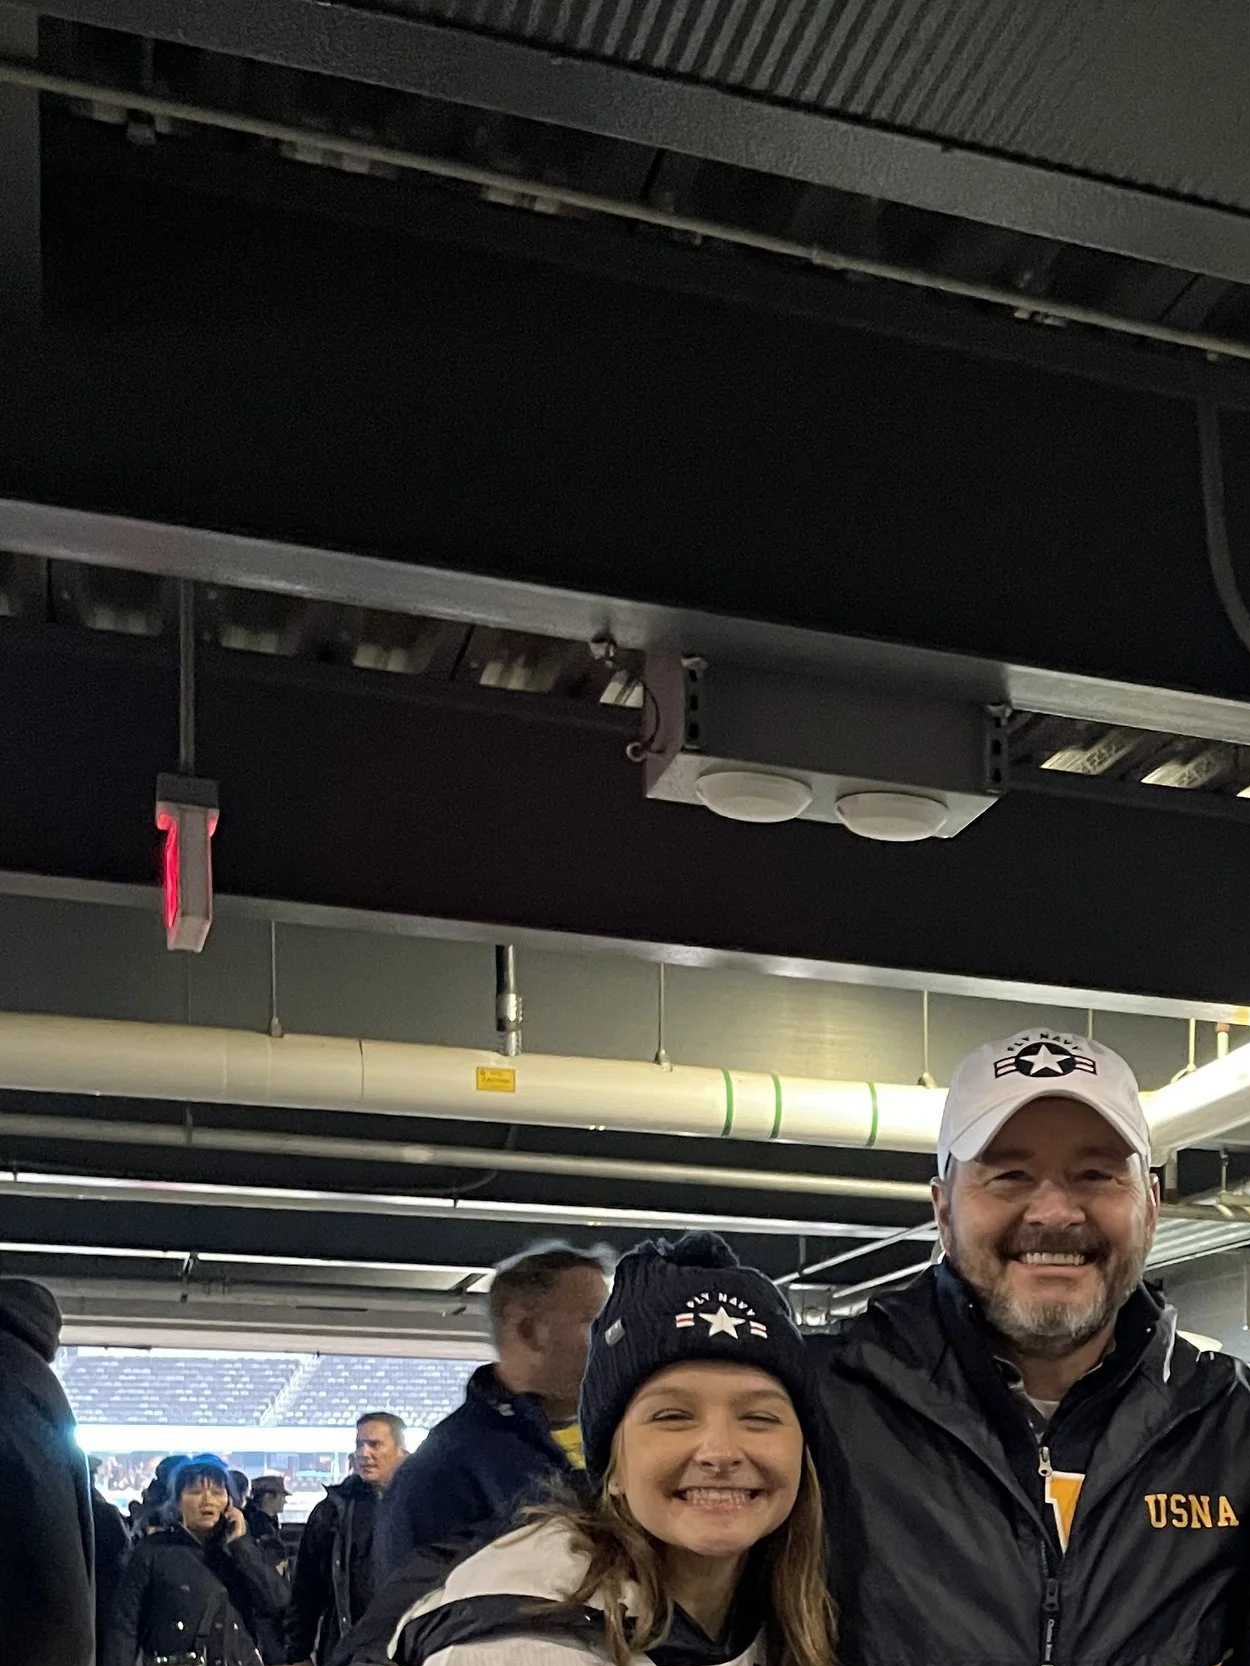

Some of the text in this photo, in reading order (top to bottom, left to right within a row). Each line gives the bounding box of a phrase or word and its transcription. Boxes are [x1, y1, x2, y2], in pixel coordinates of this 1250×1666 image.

[1007, 1033, 1082, 1051] FLY NAVY
[686, 1292, 756, 1316] FLY NAVY
[1144, 1493, 1240, 1529] USNA
